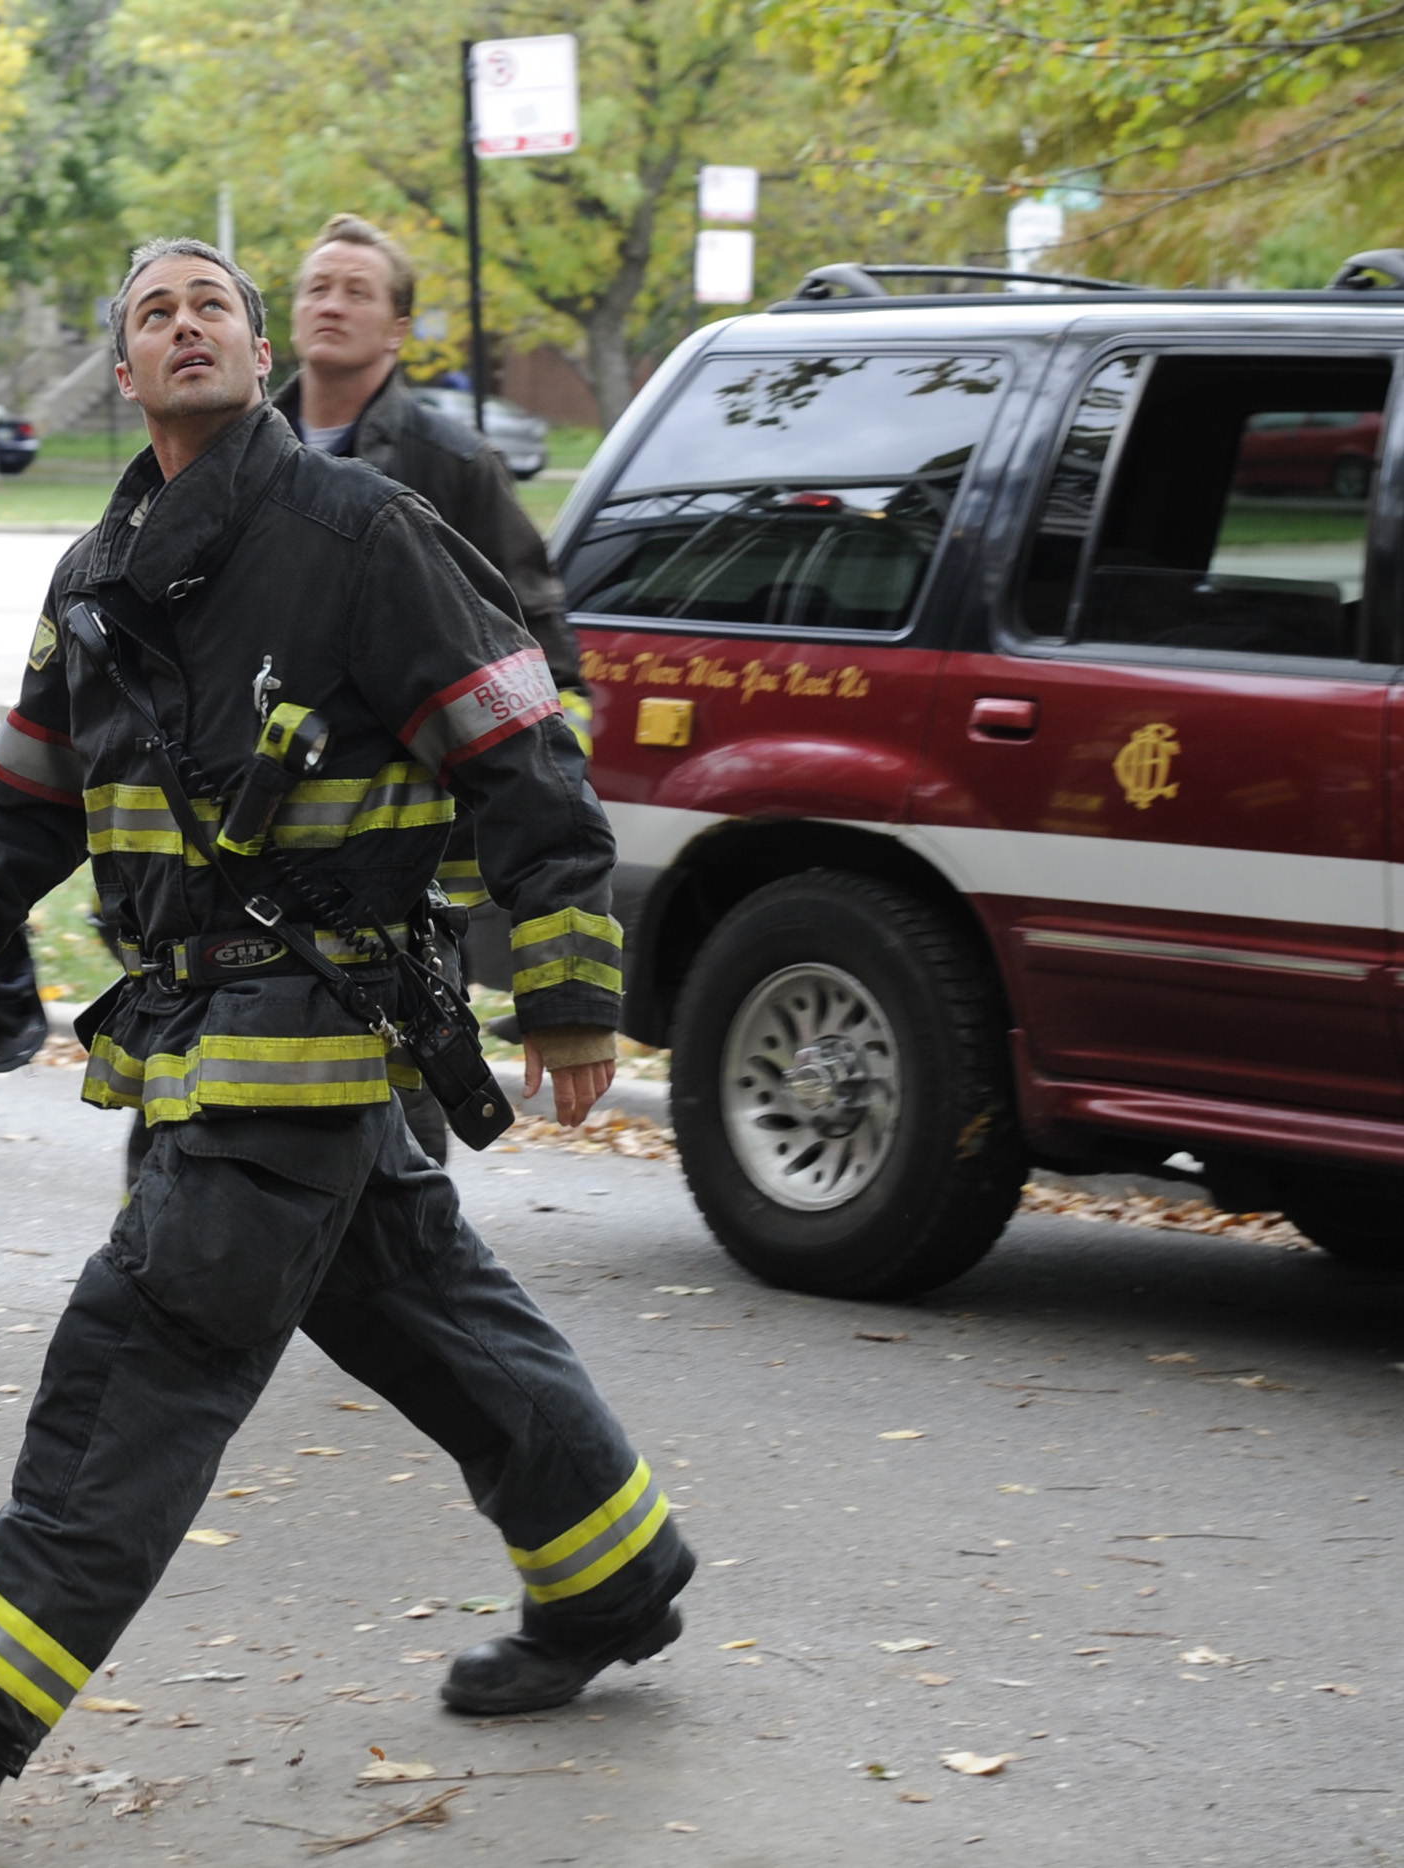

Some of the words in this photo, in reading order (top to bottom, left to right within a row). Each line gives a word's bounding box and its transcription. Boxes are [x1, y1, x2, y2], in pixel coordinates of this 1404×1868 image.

[474, 663, 546, 707] RESCUE
[739, 659, 781, 705] You
[784, 662, 838, 696] Need
[836, 665, 871, 698] Us
[215, 943, 275, 961] GUT
